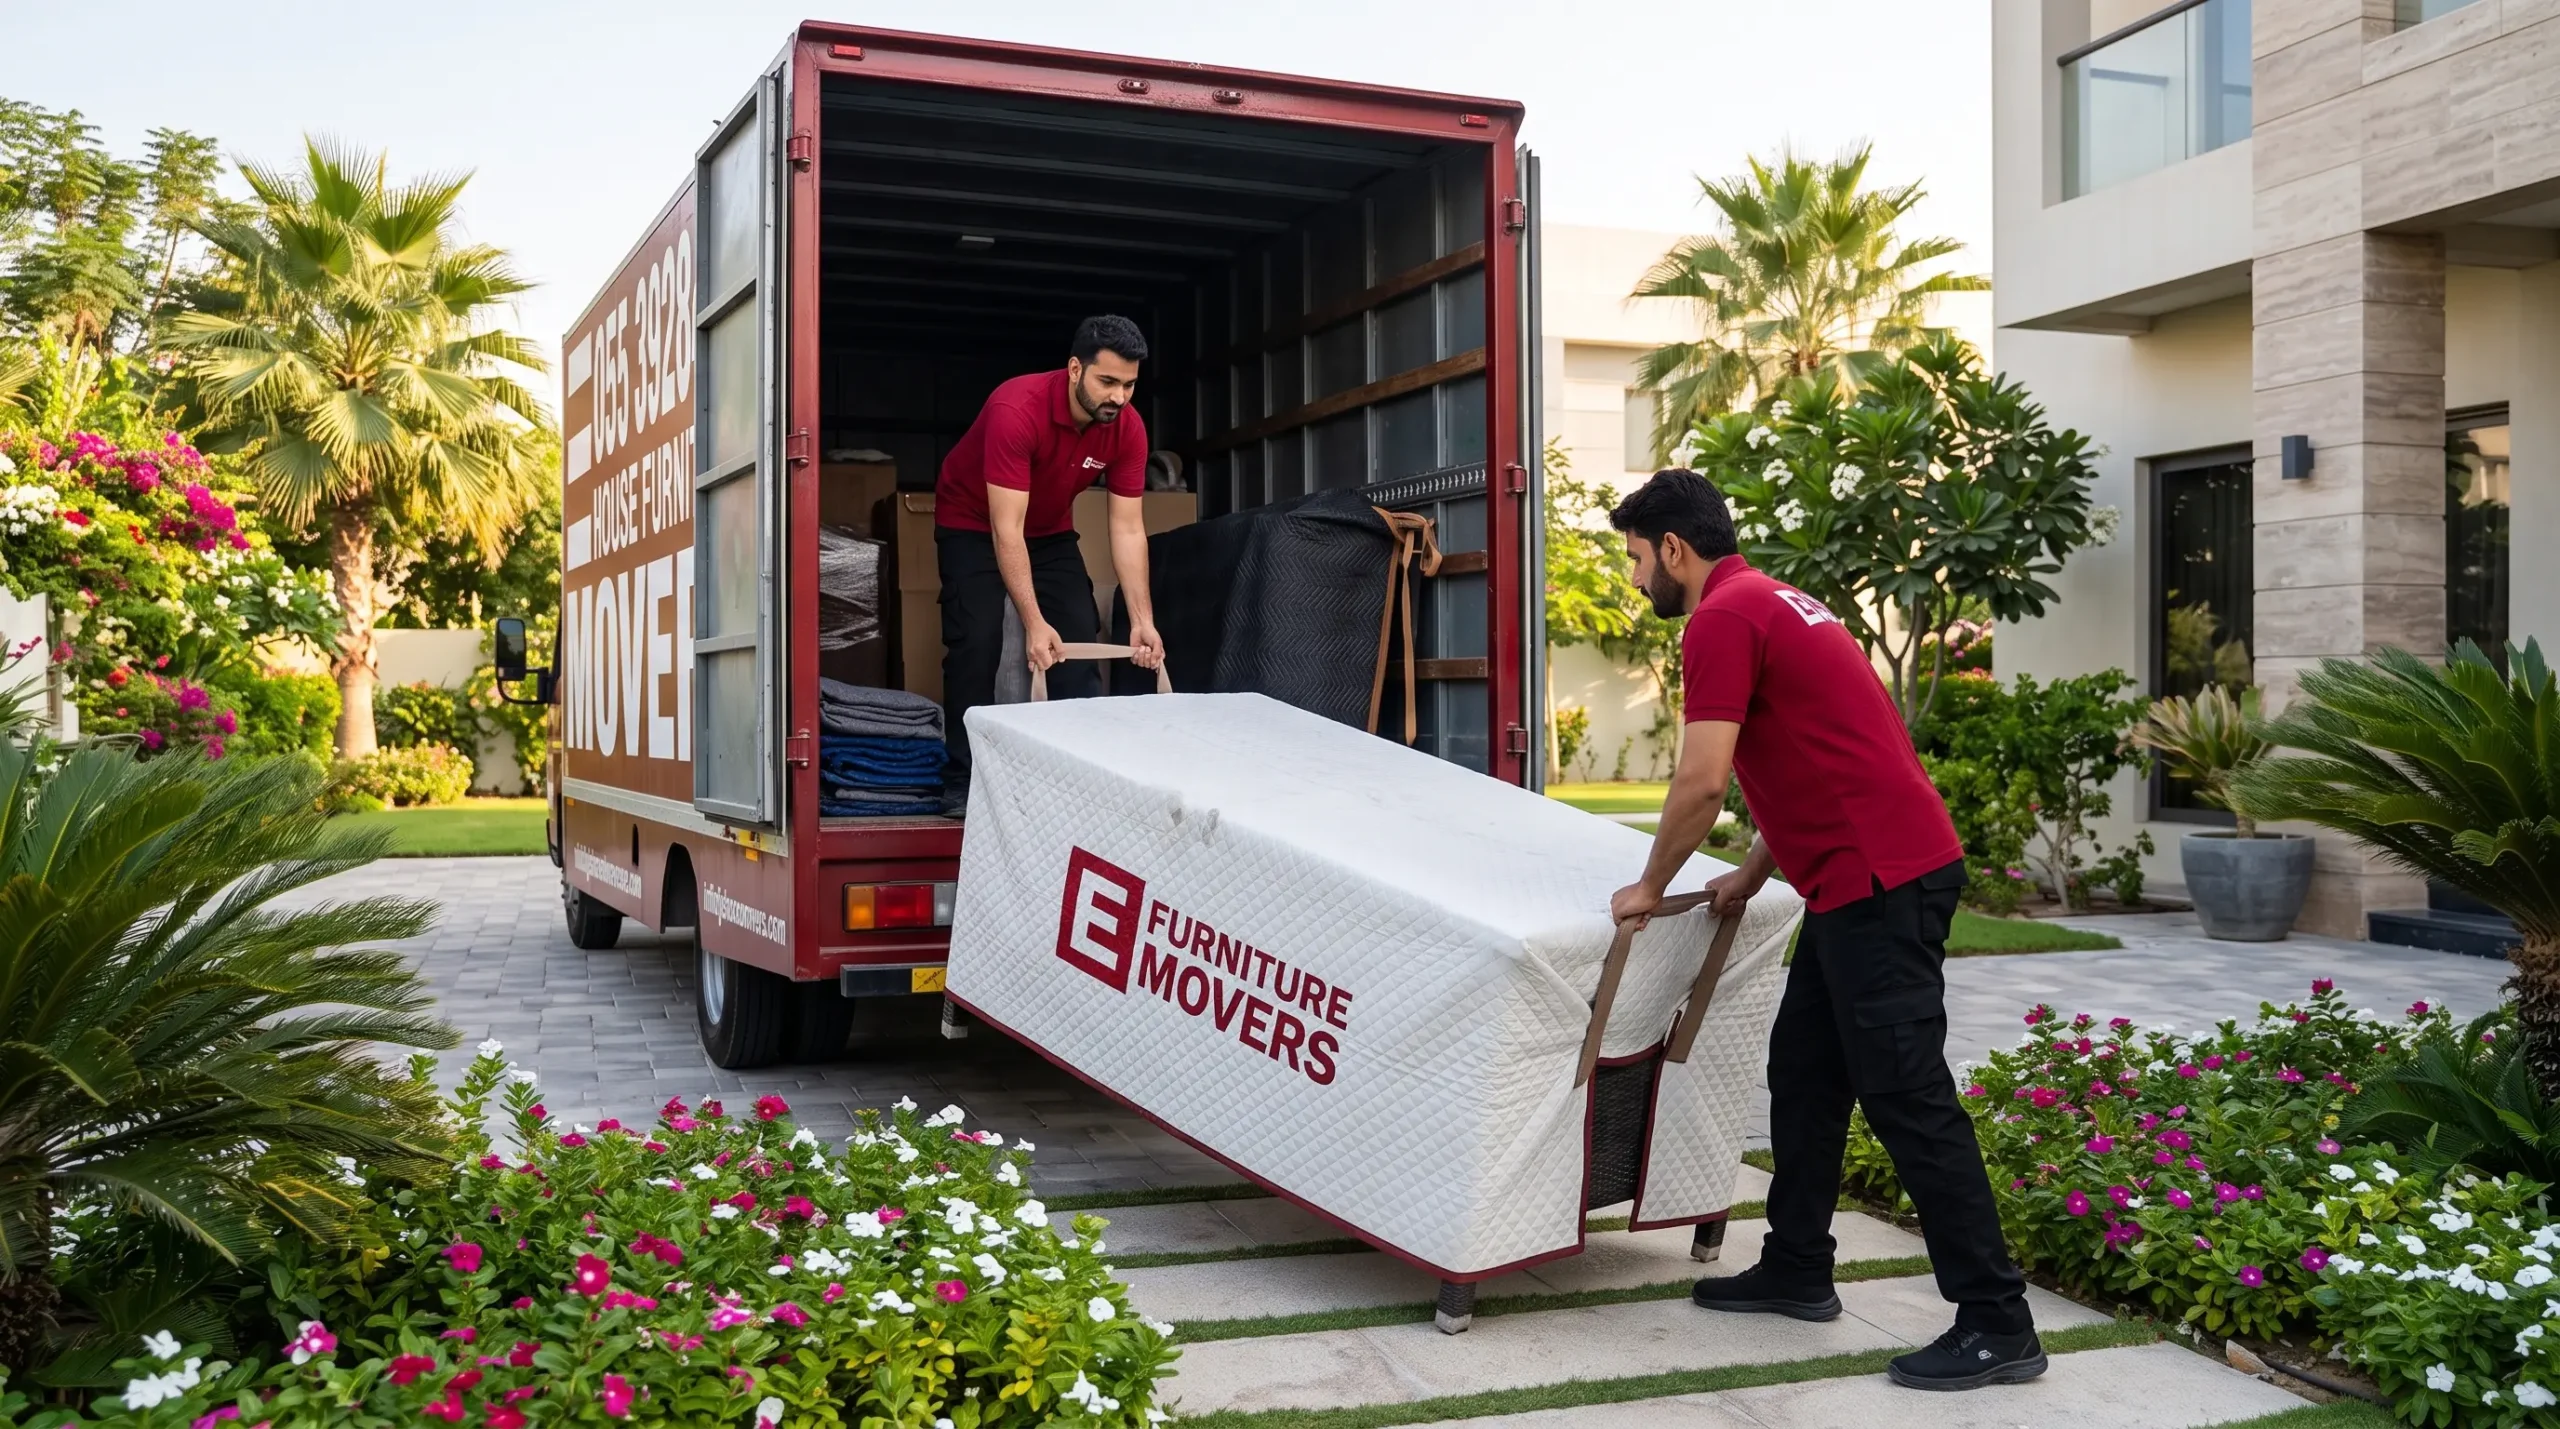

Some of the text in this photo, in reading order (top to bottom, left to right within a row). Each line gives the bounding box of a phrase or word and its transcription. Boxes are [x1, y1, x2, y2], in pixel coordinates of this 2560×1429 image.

[593, 229, 696, 464] 055 3928
[593, 461, 638, 560] HOUSE
[1137, 941, 1340, 1086] MOVERS
[1147, 899, 1353, 1031] FURNITURE
